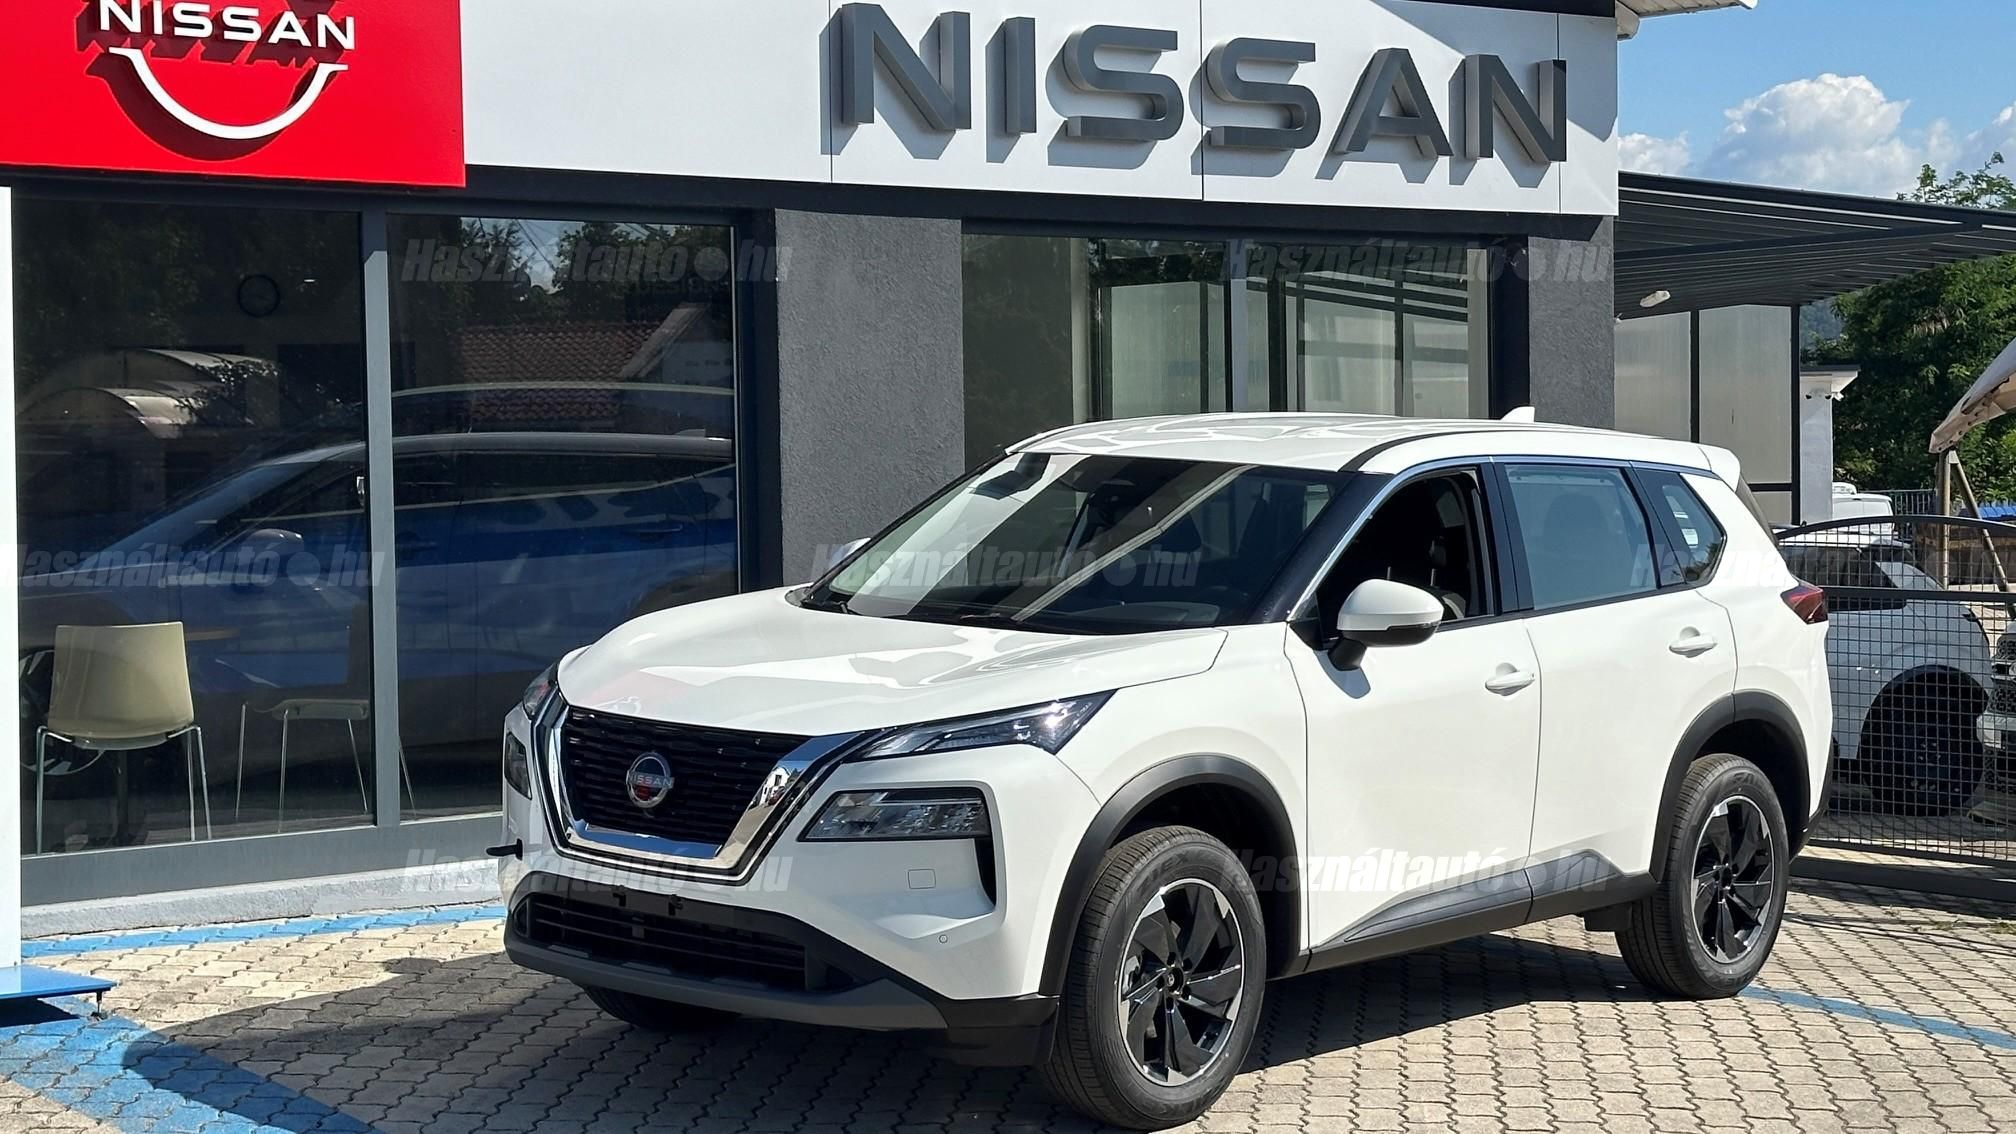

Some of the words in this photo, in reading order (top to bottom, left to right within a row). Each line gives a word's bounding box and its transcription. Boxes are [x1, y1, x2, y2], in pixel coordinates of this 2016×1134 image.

[99, 0, 355, 50] NISSAN
[841, 2, 1567, 163] NISSAN
[629, 771, 673, 788] NISSAN
